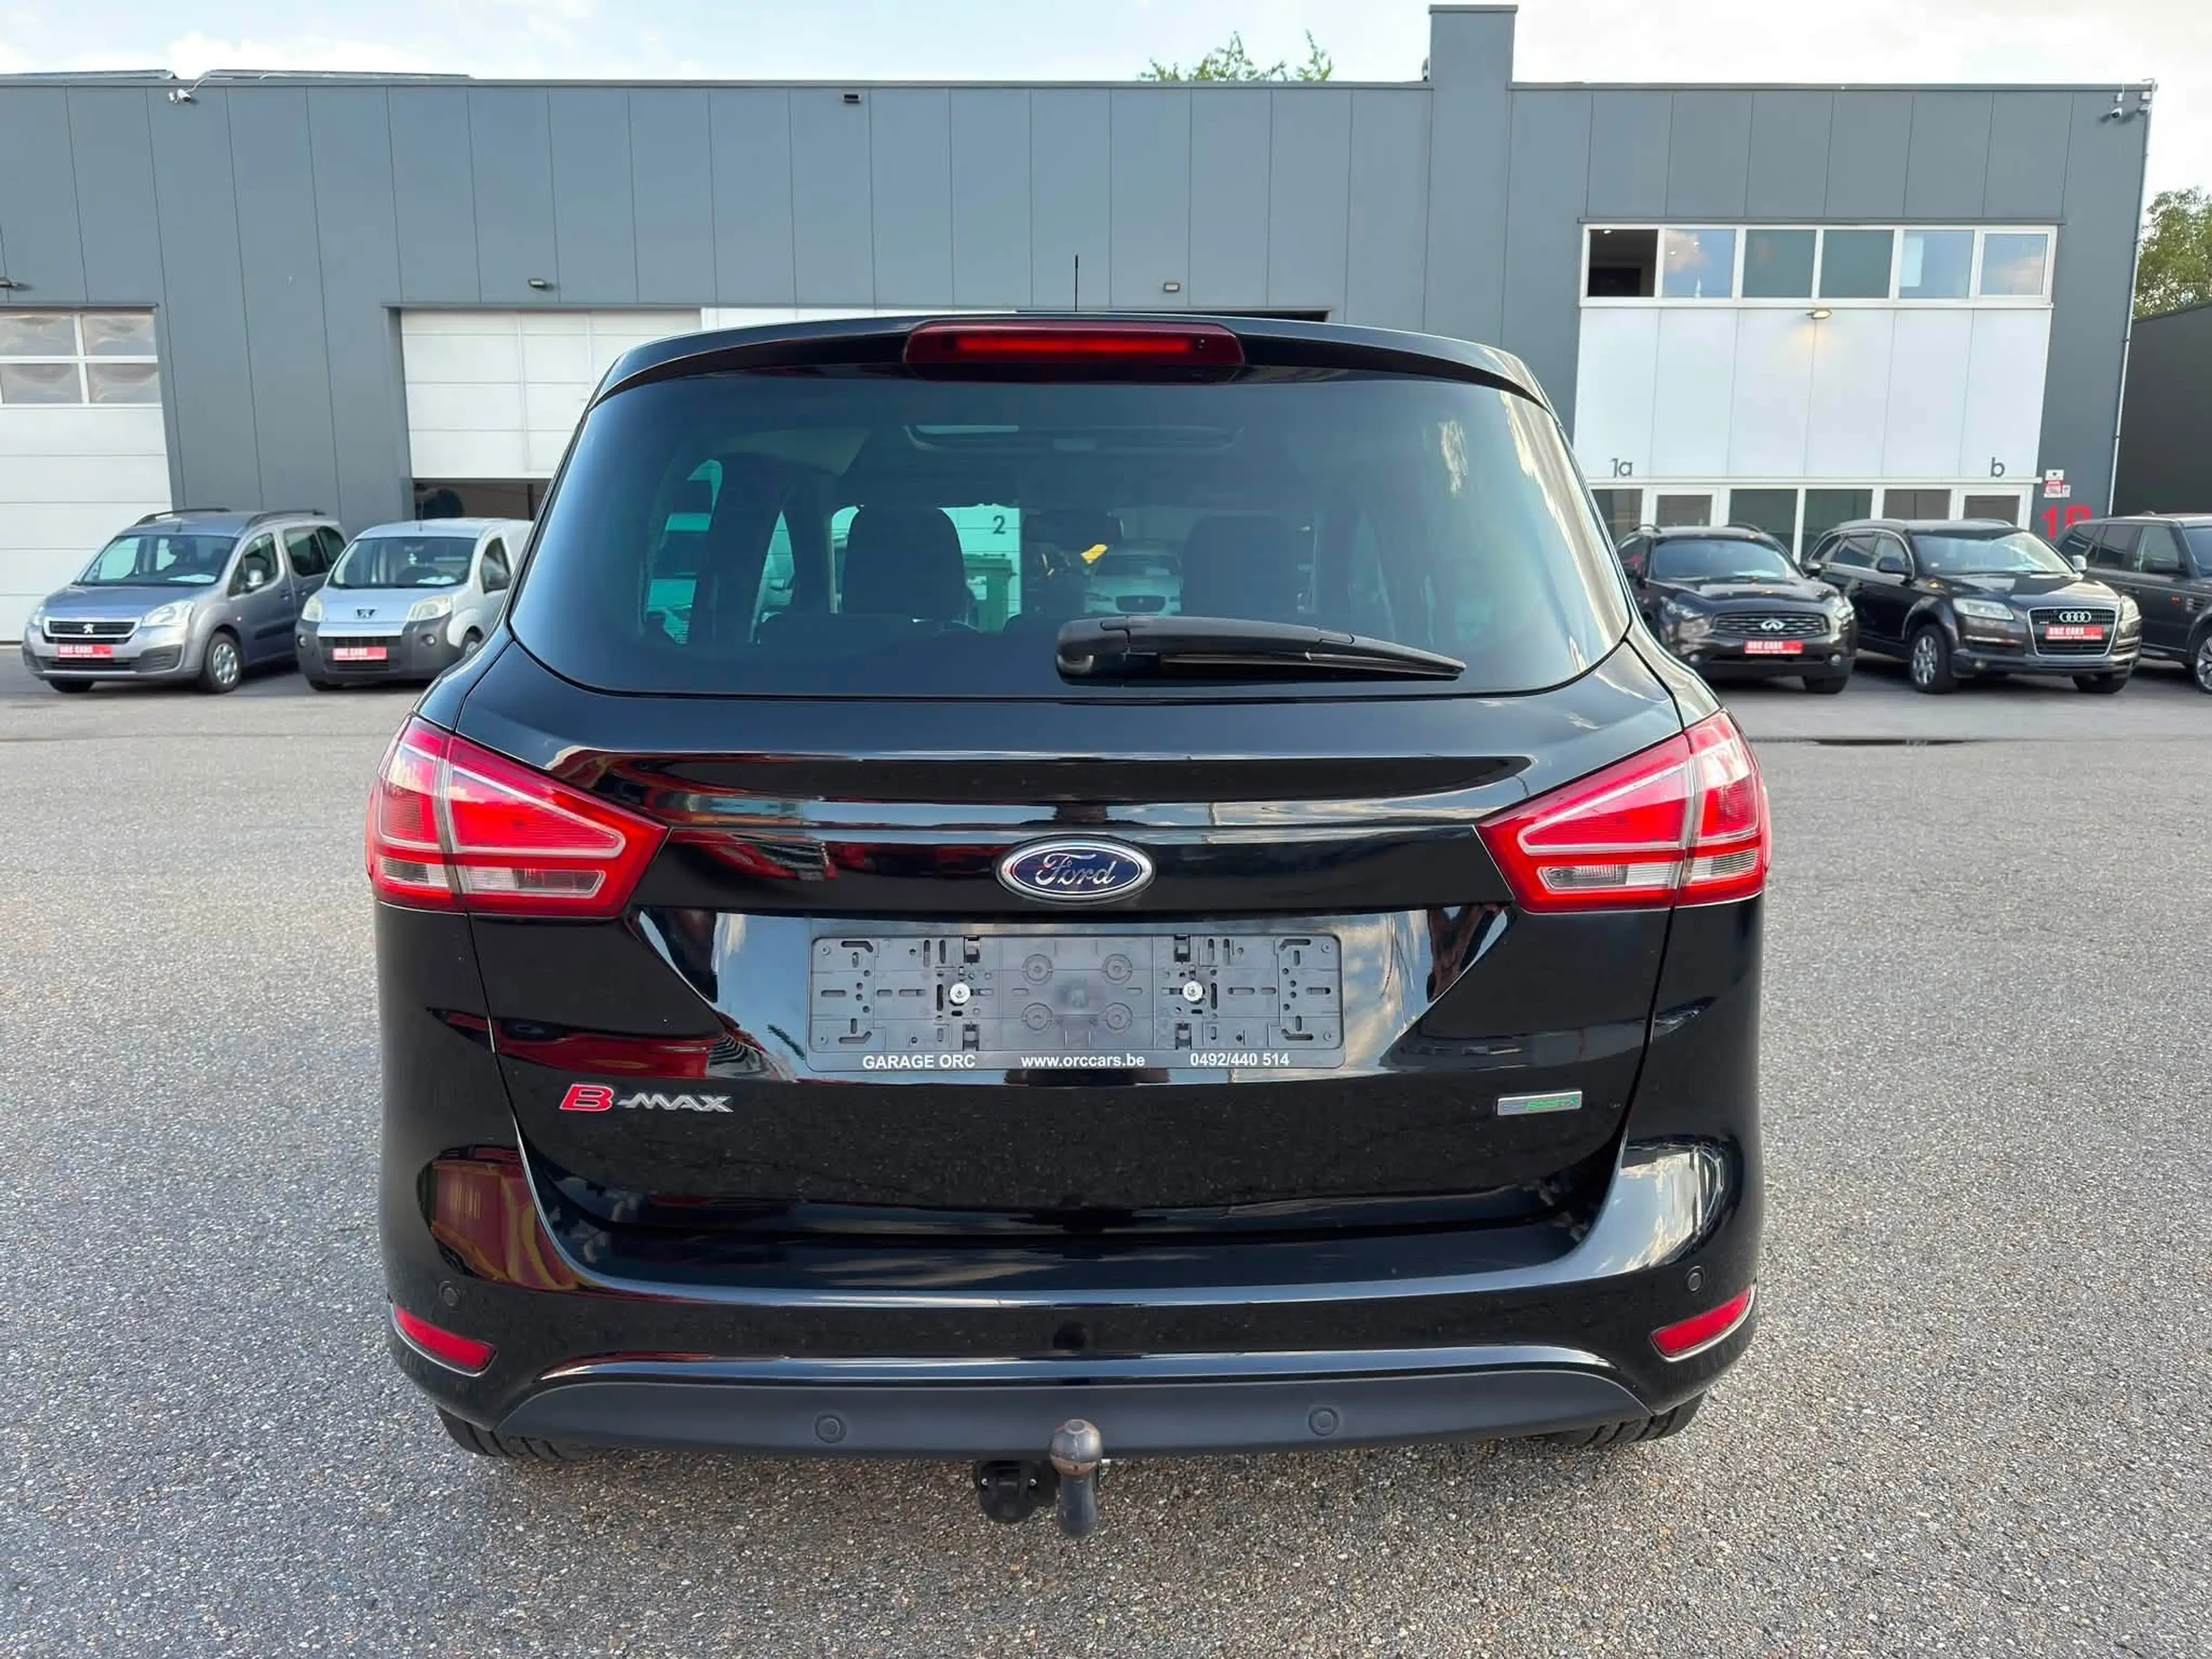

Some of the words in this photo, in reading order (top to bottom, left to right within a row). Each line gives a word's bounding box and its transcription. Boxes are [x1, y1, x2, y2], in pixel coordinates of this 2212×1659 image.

[1990, 457, 2005, 478] b
[993, 515, 1006, 535] 2
[1035, 852, 1117, 885] Ford
[862, 1055, 934, 1069] GARAGE
[938, 1054, 976, 1069] ORC
[1020, 1053, 1146, 1068] www.orccars.be
[1190, 1052, 1257, 1067] 0492/440
[1262, 1052, 1290, 1066] 514
[559, 1083, 734, 1113] B-MAX
